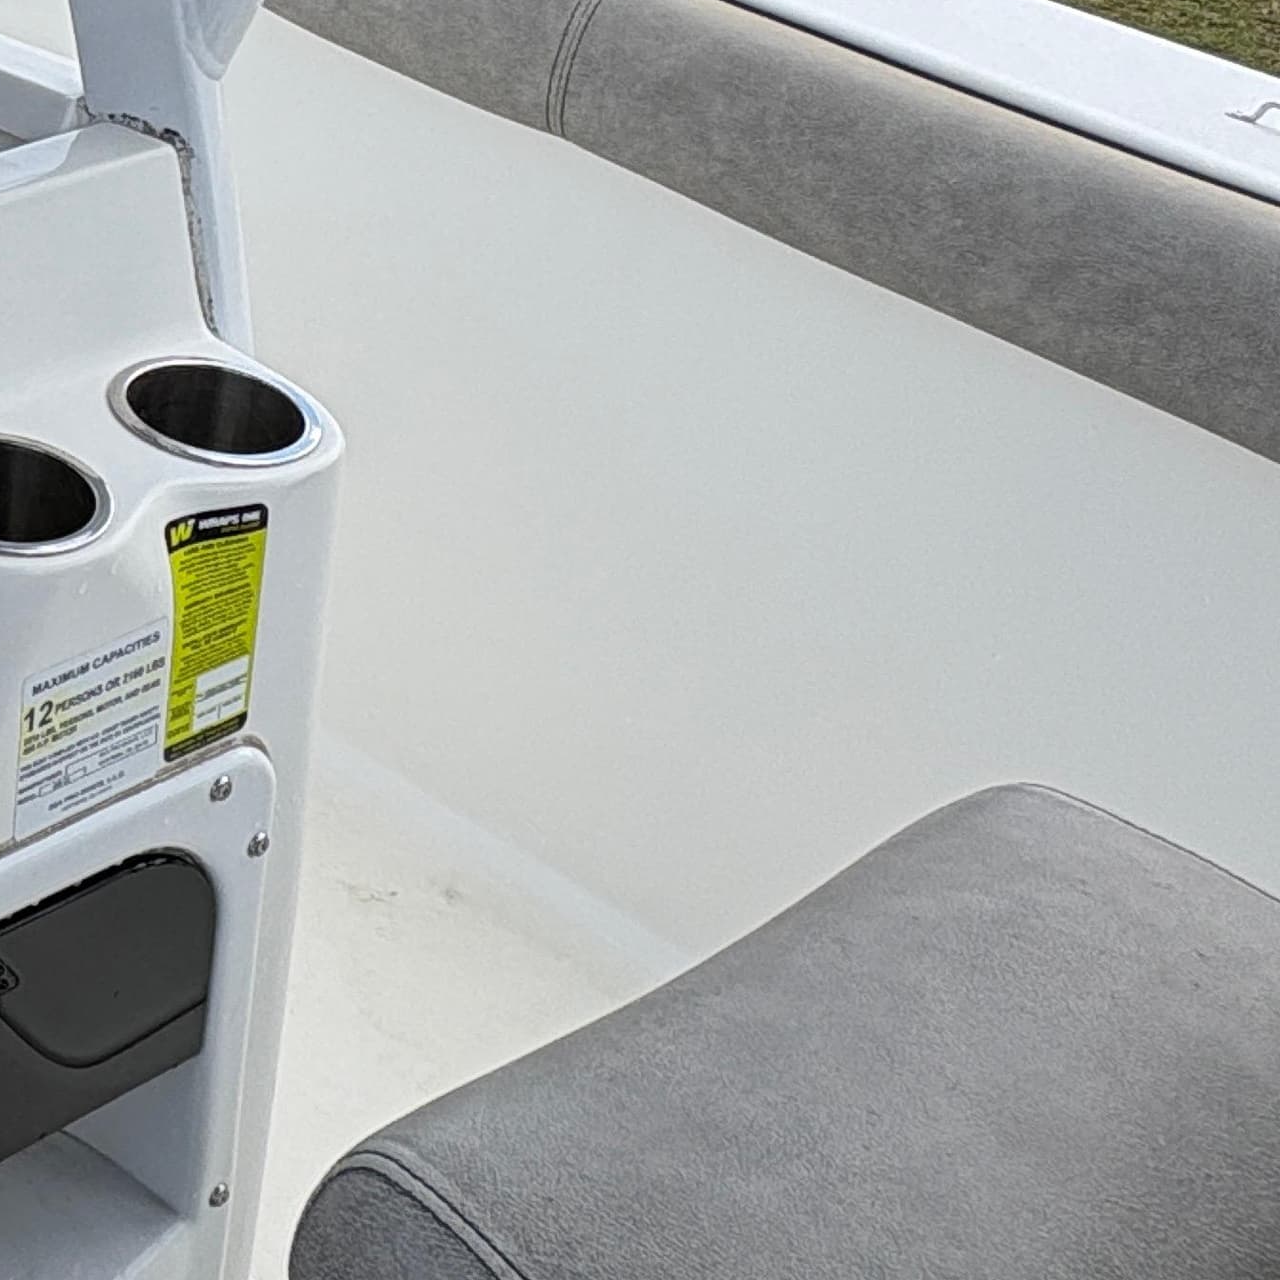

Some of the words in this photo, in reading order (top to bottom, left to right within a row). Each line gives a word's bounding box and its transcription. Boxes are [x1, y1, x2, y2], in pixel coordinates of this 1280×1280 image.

[24, 700, 54, 732] 12
[54, 684, 103, 714] PERSONS
[105, 677, 121, 692] OR
[145, 656, 165, 674] LBS
[32, 662, 90, 696] MAXIMUM
[92, 631, 160, 669] CAPACITIES
